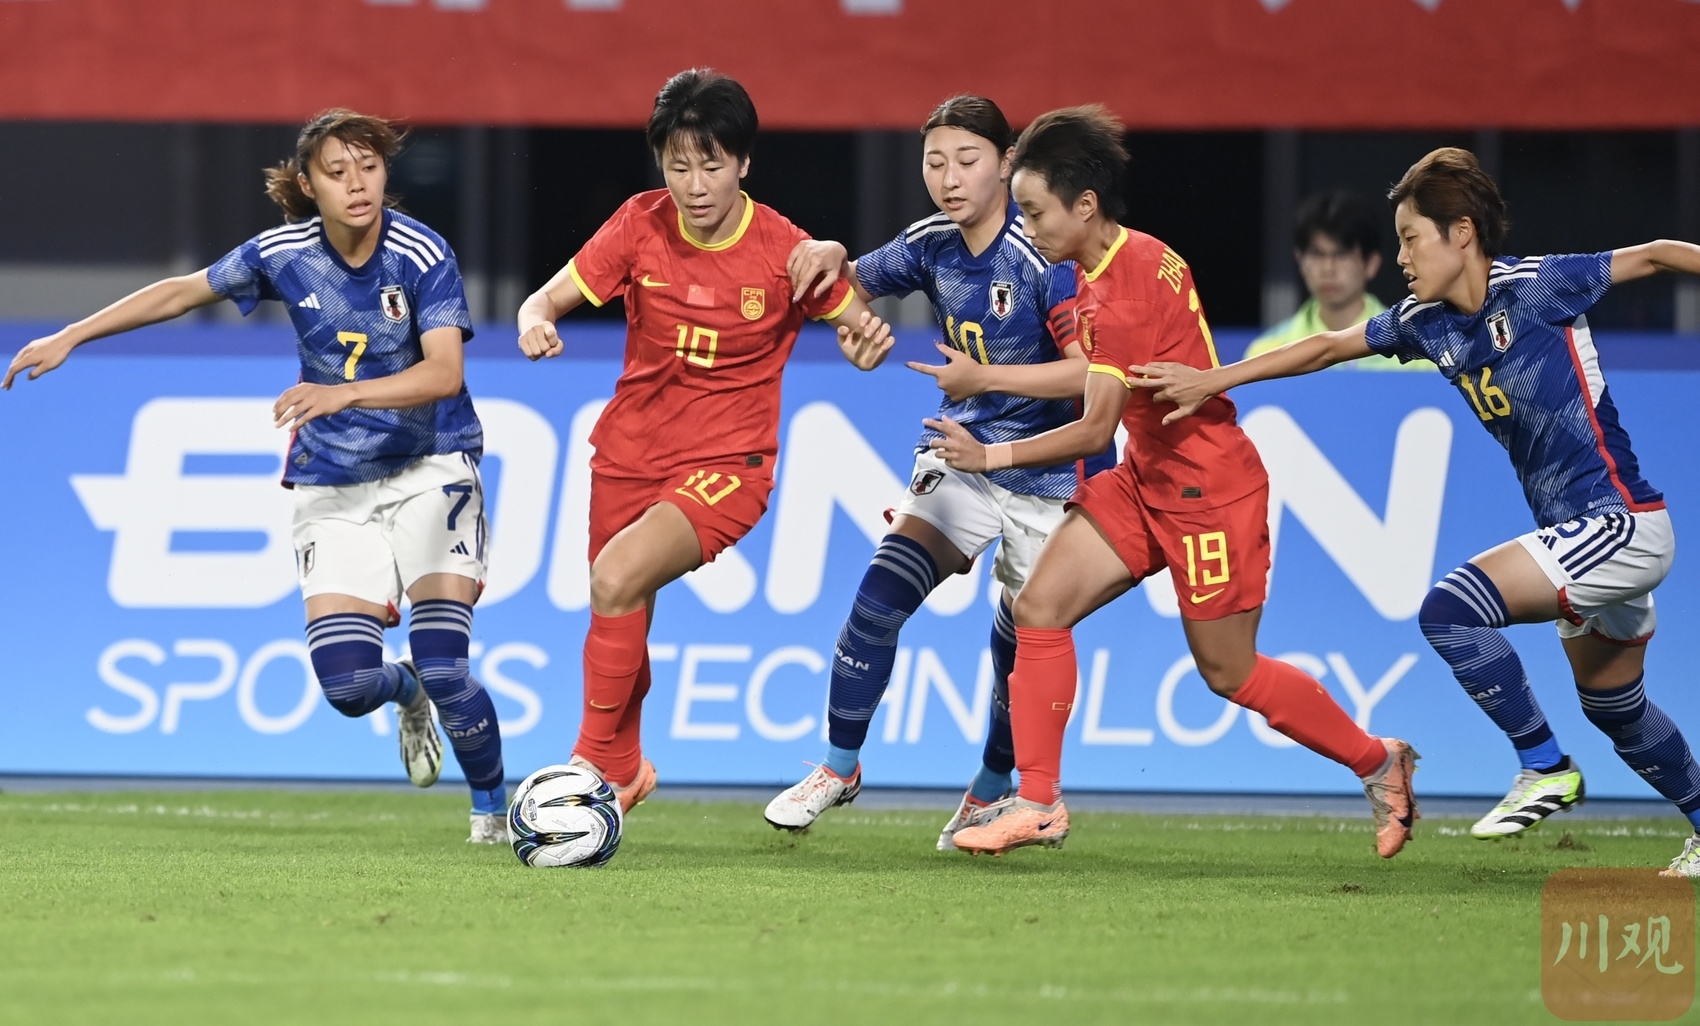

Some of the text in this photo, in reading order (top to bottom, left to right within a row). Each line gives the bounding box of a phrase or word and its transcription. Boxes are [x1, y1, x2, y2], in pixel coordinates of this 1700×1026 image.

[337, 331, 368, 380] 7
[676, 324, 719, 369] 10
[1460, 367, 1512, 421] 16
[70, 397, 1454, 621] BNN
[442, 485, 473, 531] 7
[684, 469, 742, 507] 10
[1182, 531, 1230, 586] 19
[85, 637, 1419, 748] SPOS ECHNLOY
